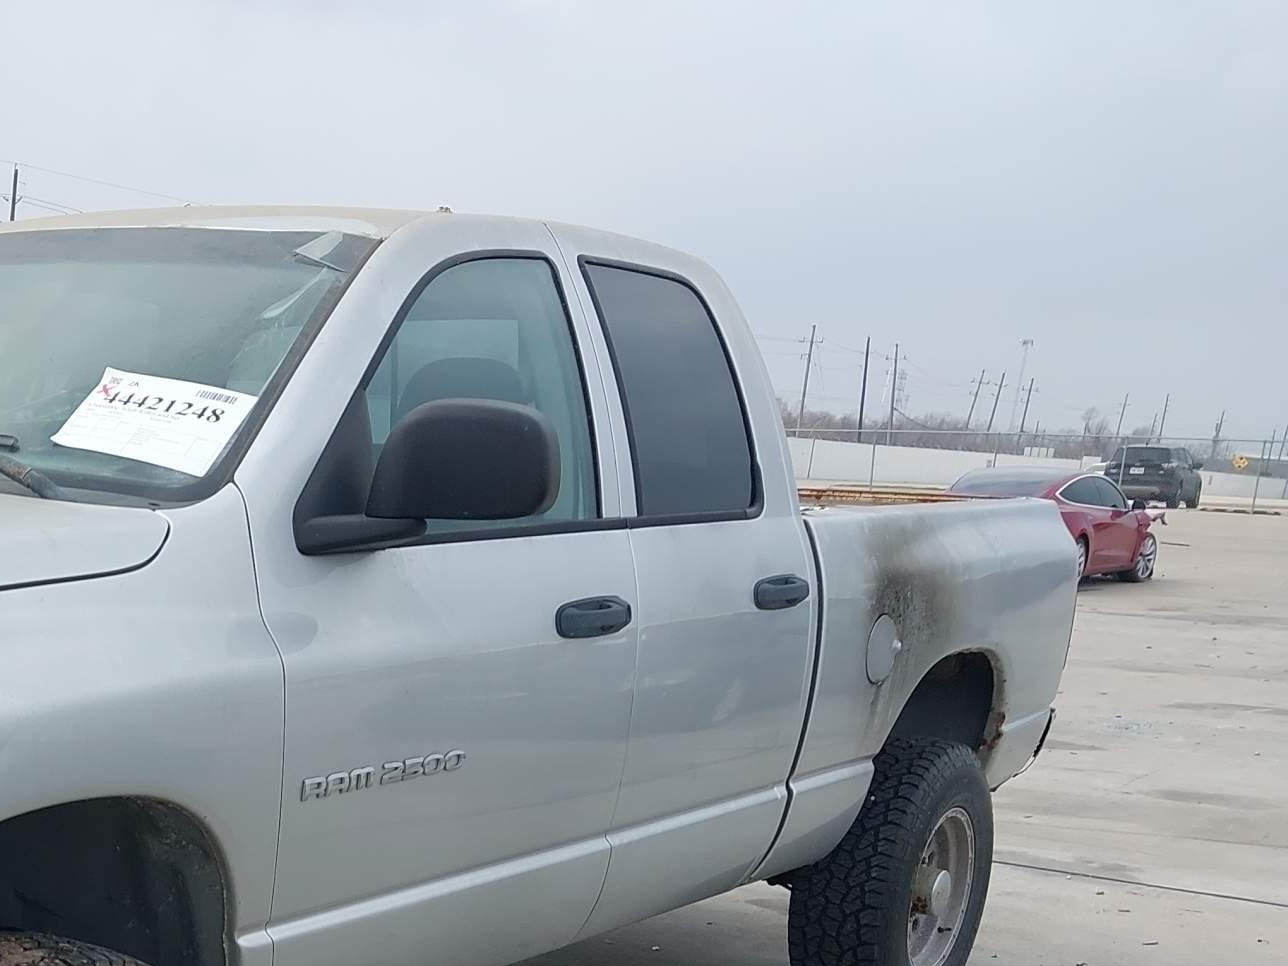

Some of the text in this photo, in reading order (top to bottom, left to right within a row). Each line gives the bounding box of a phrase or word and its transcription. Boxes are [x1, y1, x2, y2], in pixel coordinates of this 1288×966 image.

[103, 390, 225, 423] 44421248
[300, 748, 467, 802] RAM 2500
